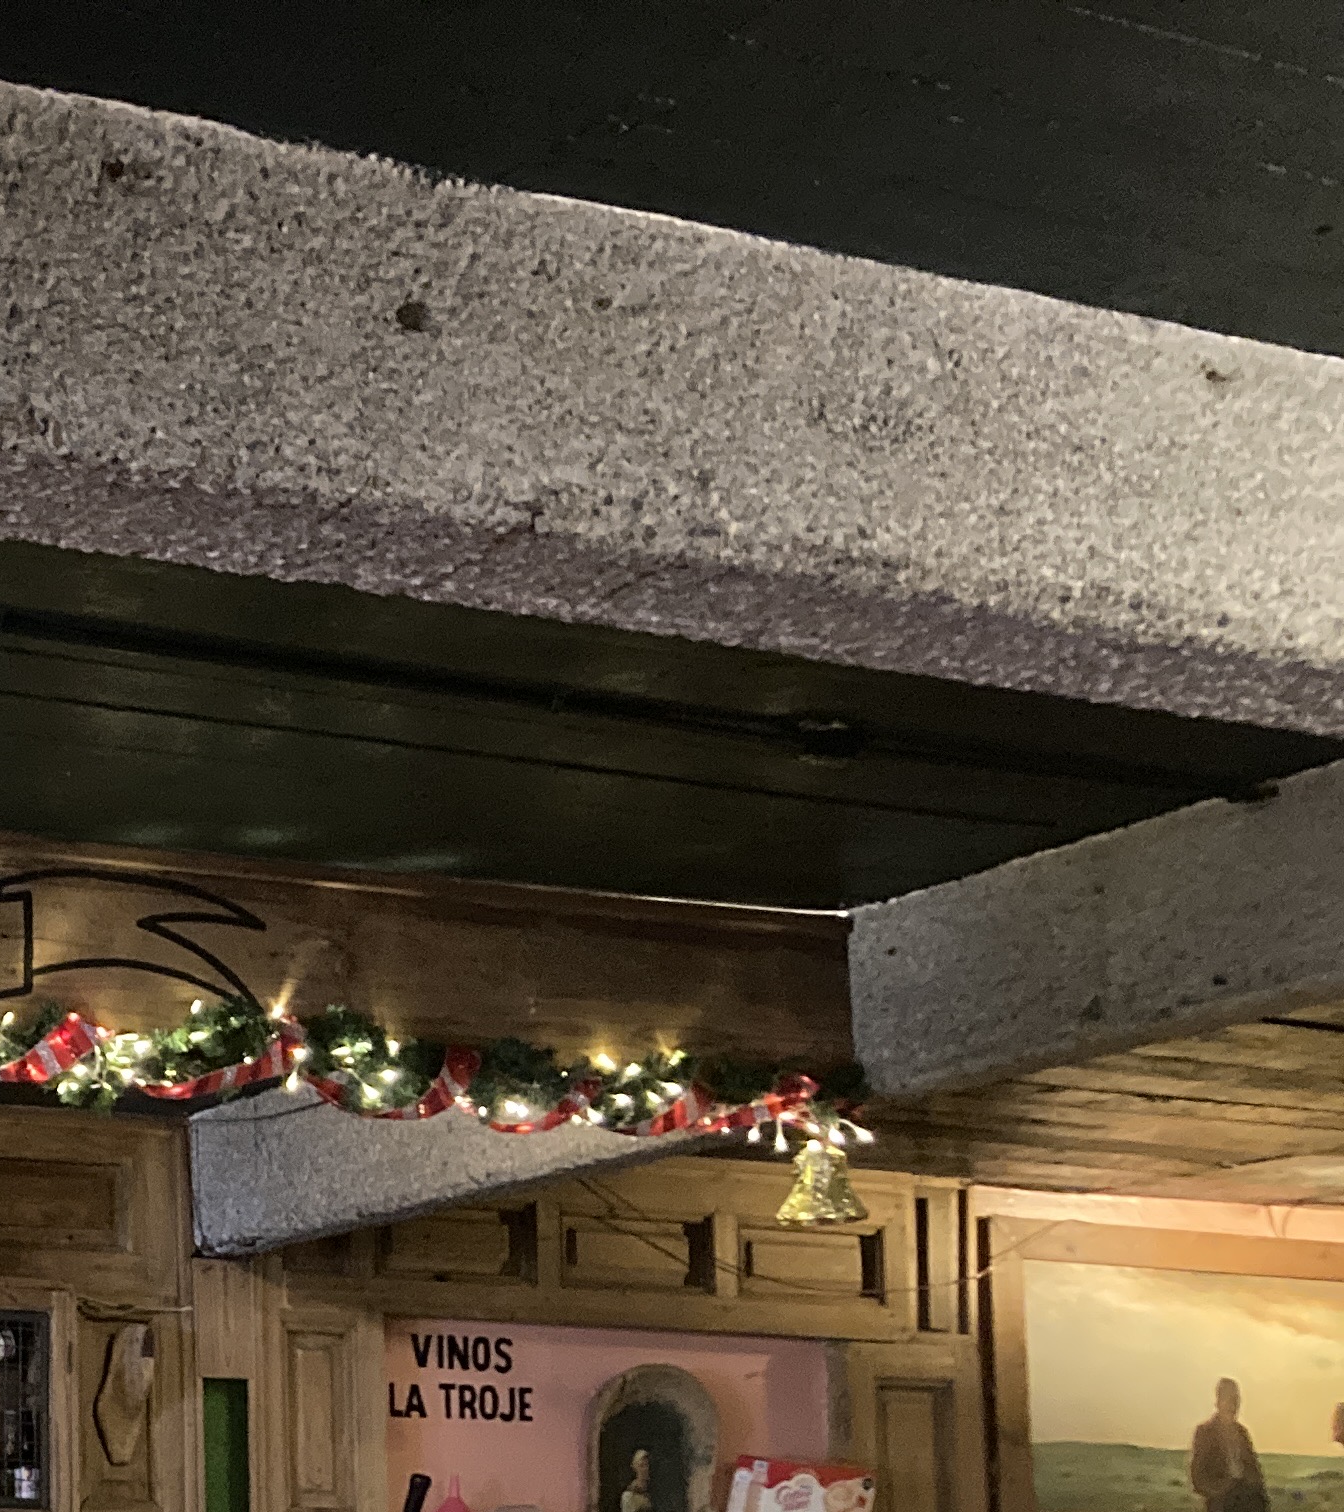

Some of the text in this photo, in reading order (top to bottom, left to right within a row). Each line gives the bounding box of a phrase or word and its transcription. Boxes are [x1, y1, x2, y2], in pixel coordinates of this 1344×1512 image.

[410, 1333, 514, 1374] VINOS
[388, 1382, 534, 1422] LA TROJE
